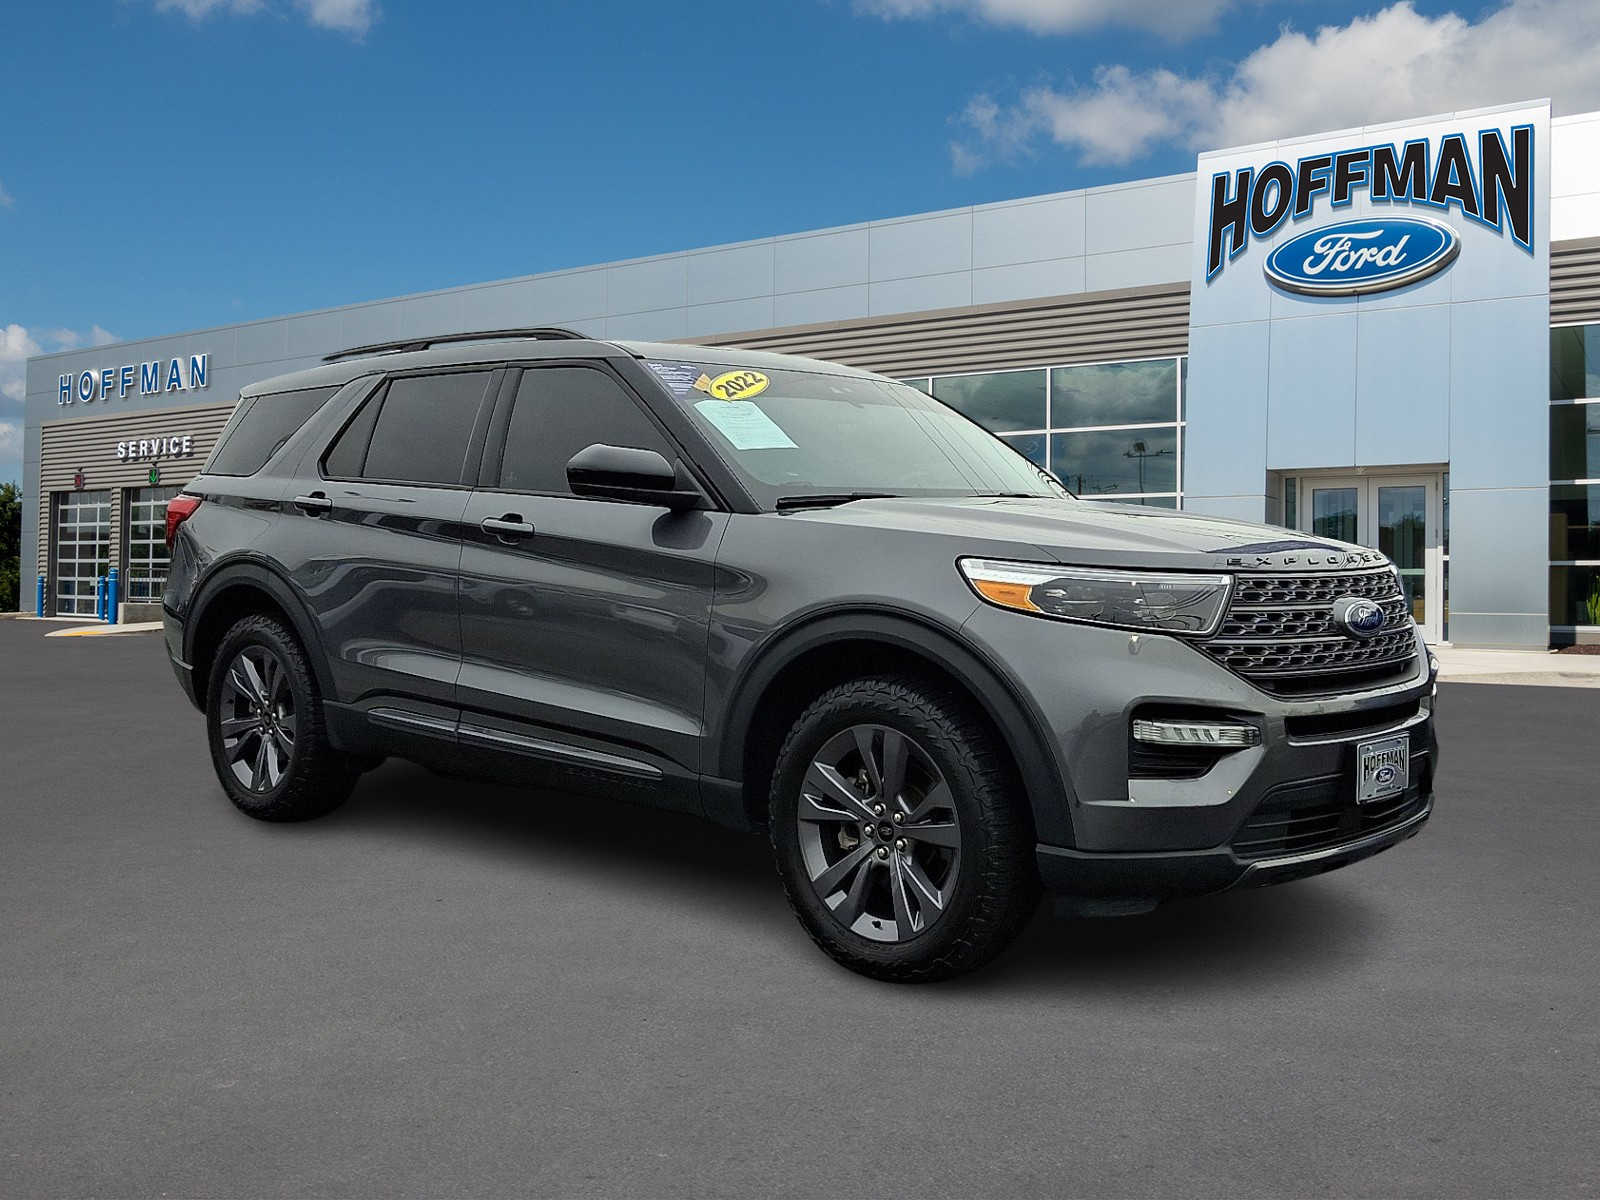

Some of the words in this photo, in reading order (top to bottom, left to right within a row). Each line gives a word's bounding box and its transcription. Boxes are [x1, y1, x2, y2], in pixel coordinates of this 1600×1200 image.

[1207, 124, 1534, 282] HOFFMAN
[1303, 229, 1410, 275] Ford
[58, 354, 208, 404] HOFFMAN
[715, 372, 764, 398] 2022
[117, 436, 191, 457] SERVICE
[1362, 747, 1405, 784] HOFFMAN
